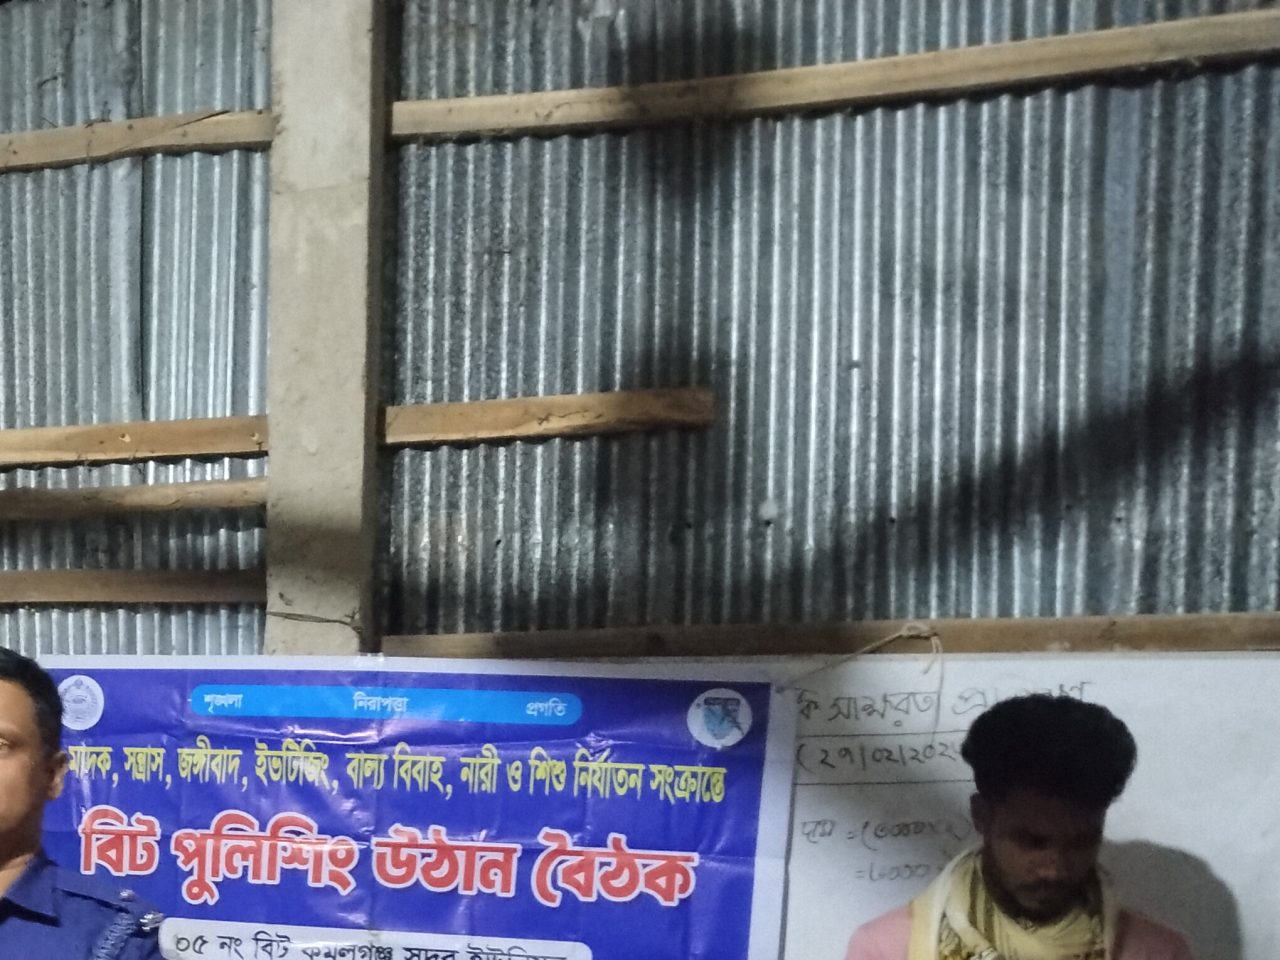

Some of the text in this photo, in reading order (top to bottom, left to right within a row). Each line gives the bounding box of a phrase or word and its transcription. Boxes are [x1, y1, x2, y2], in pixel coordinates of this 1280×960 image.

[353, 691, 408, 713] নিরাপত্তা
[525, 698, 568, 717] প্রগতি
[68, 745, 119, 788] মাদক,
[123, 746, 172, 790] সন্ত্রাস,
[177, 735, 249, 791] জঙ্গীবাদ,
[345, 751, 388, 790] বাল্য
[393, 742, 453, 801] বিবাহ,
[460, 743, 501, 794] নারী
[507, 760, 523, 792] ও
[529, 746, 567, 796] শিশু
[573, 747, 646, 800] নির্যাতন
[649, 762, 728, 805] সংক্রান্তে
[80, 803, 699, 906] বিট পুলিশিং উঠান বৈঠক
[175, 934, 209, 955] ০৫
[216, 935, 245, 960] নং
[252, 930, 292, 960] বিট
